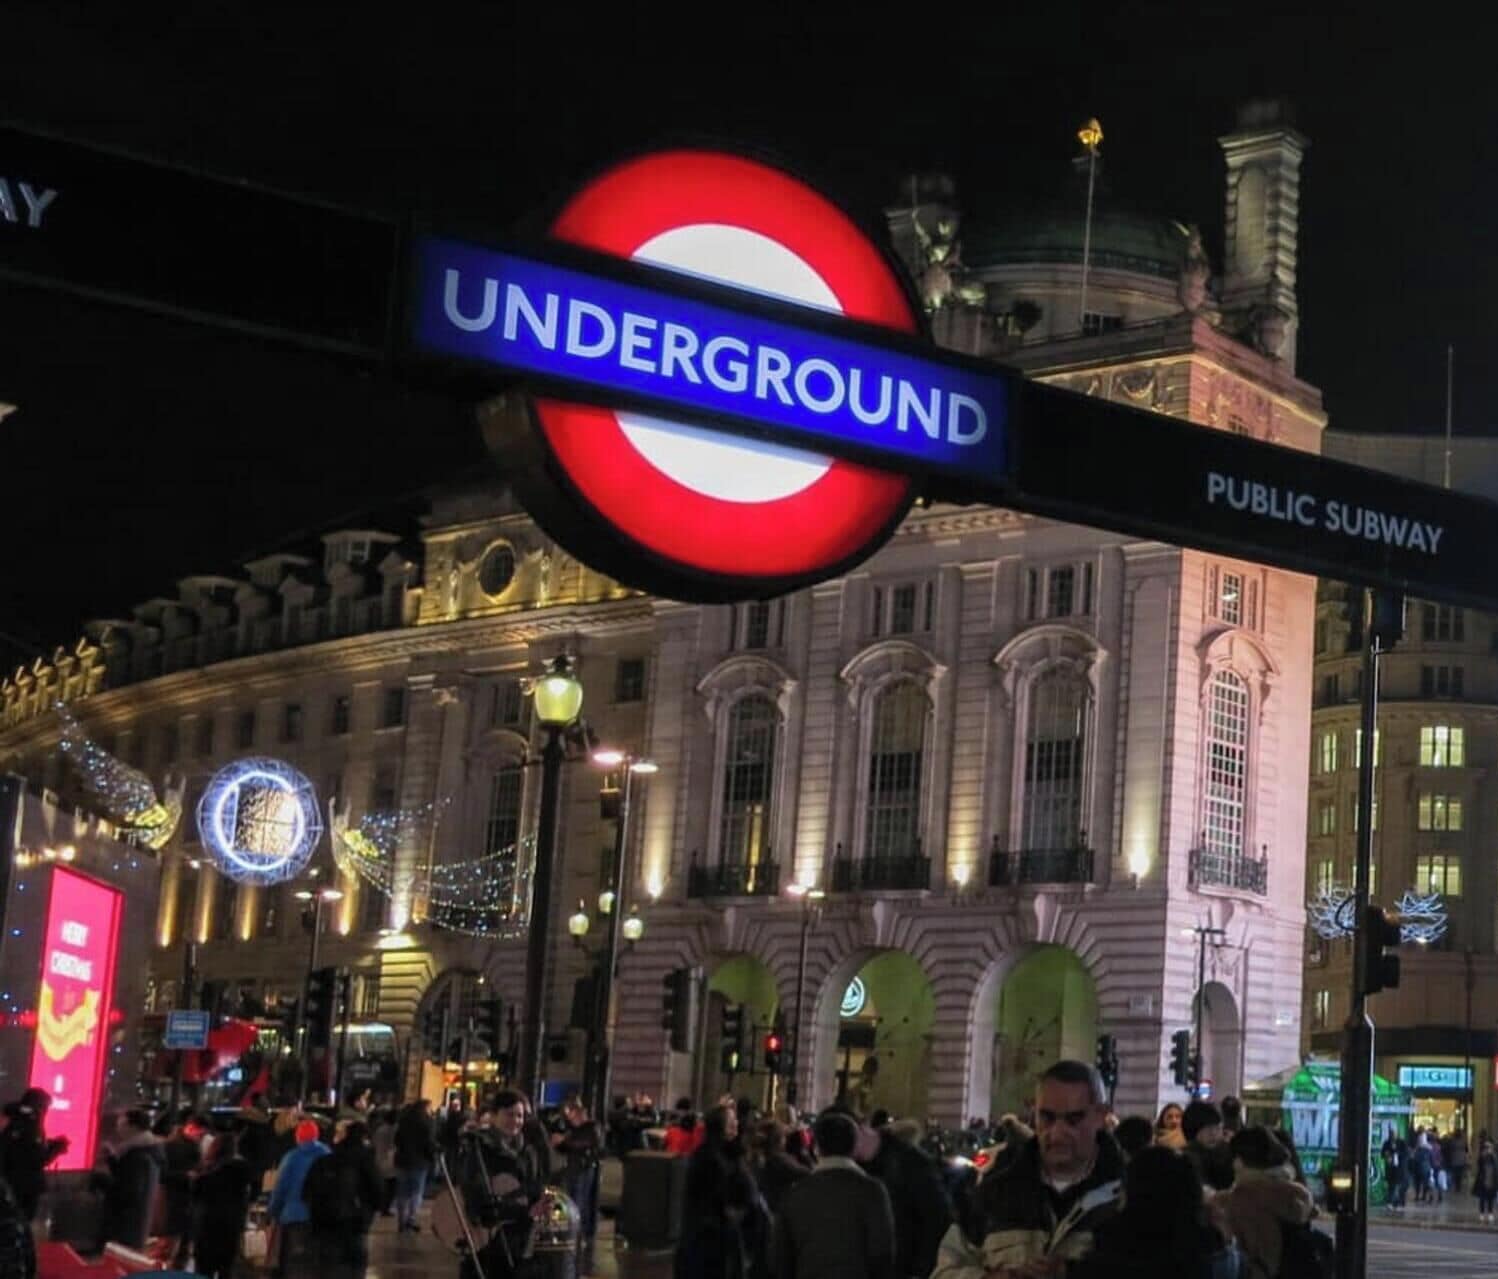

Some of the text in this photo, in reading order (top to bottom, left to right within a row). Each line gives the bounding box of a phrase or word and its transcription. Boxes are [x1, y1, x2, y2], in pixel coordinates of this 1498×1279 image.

[443, 268, 987, 446] UNDERGROUND
[1207, 472, 1444, 555] PUBLIC SUBWAY
